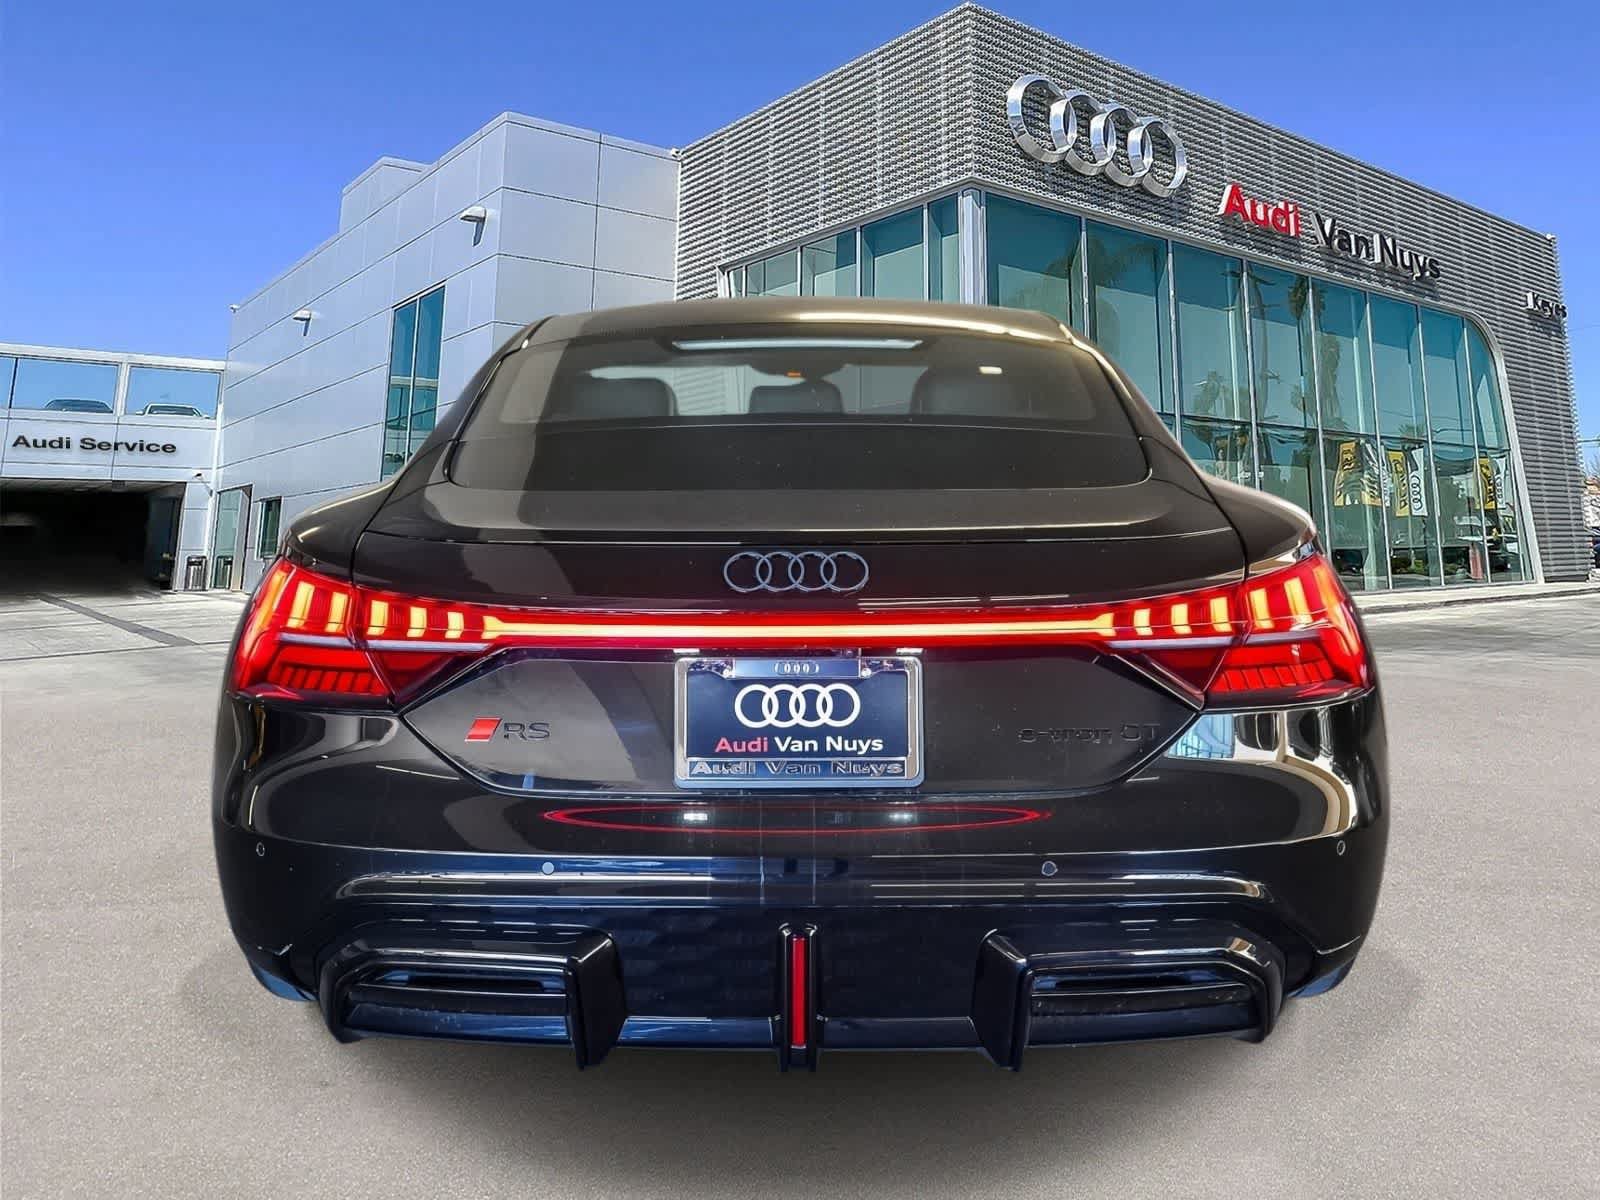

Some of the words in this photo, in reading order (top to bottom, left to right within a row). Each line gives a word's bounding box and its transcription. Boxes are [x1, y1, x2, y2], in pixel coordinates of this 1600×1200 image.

[1217, 182, 1302, 237] Audi
[1312, 211, 1371, 259] Van
[1374, 233, 1442, 280] Nuys
[12, 435, 71, 449] Audi
[79, 437, 177, 453] Service
[503, 722, 551, 741] RS
[715, 737, 769, 752] Audi
[774, 736, 818, 752] Van
[826, 735, 884, 755] Nuys
[690, 761, 756, 775] Audi
[765, 761, 821, 775] Van
[830, 761, 905, 777] Nuys
